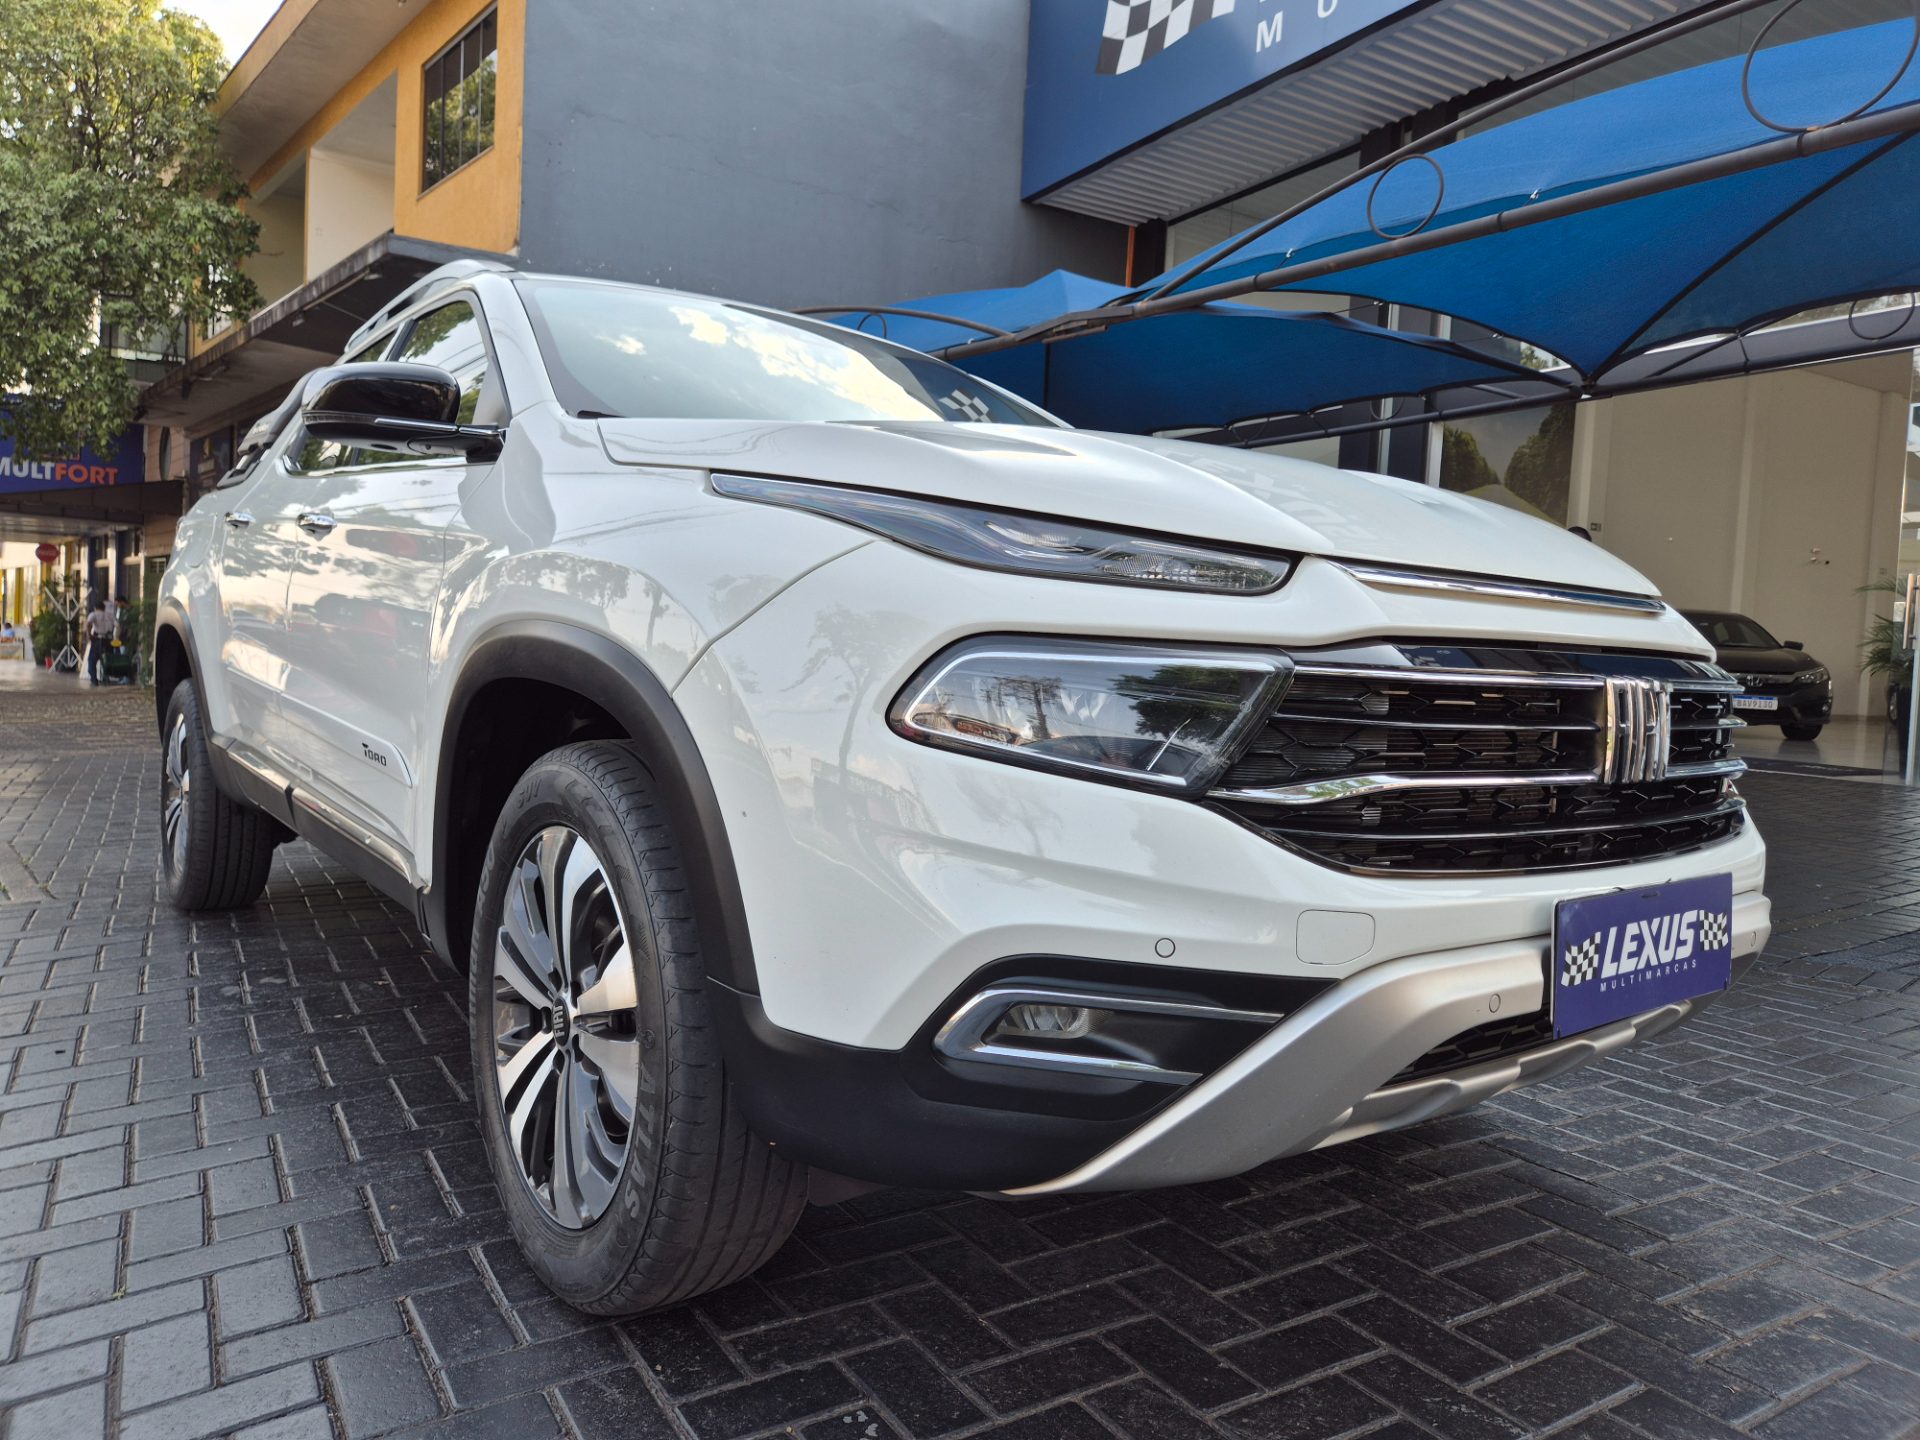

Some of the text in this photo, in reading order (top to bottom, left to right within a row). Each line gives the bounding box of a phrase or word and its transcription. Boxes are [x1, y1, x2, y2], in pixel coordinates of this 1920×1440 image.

[361, 742, 387, 767] TORO
[1600, 909, 1699, 979] LEXUS
[1600, 958, 1698, 992] MULTIMARCAS
[553, 1005, 565, 1038] FIAT
[624, 1061, 656, 1218] ATLAS
